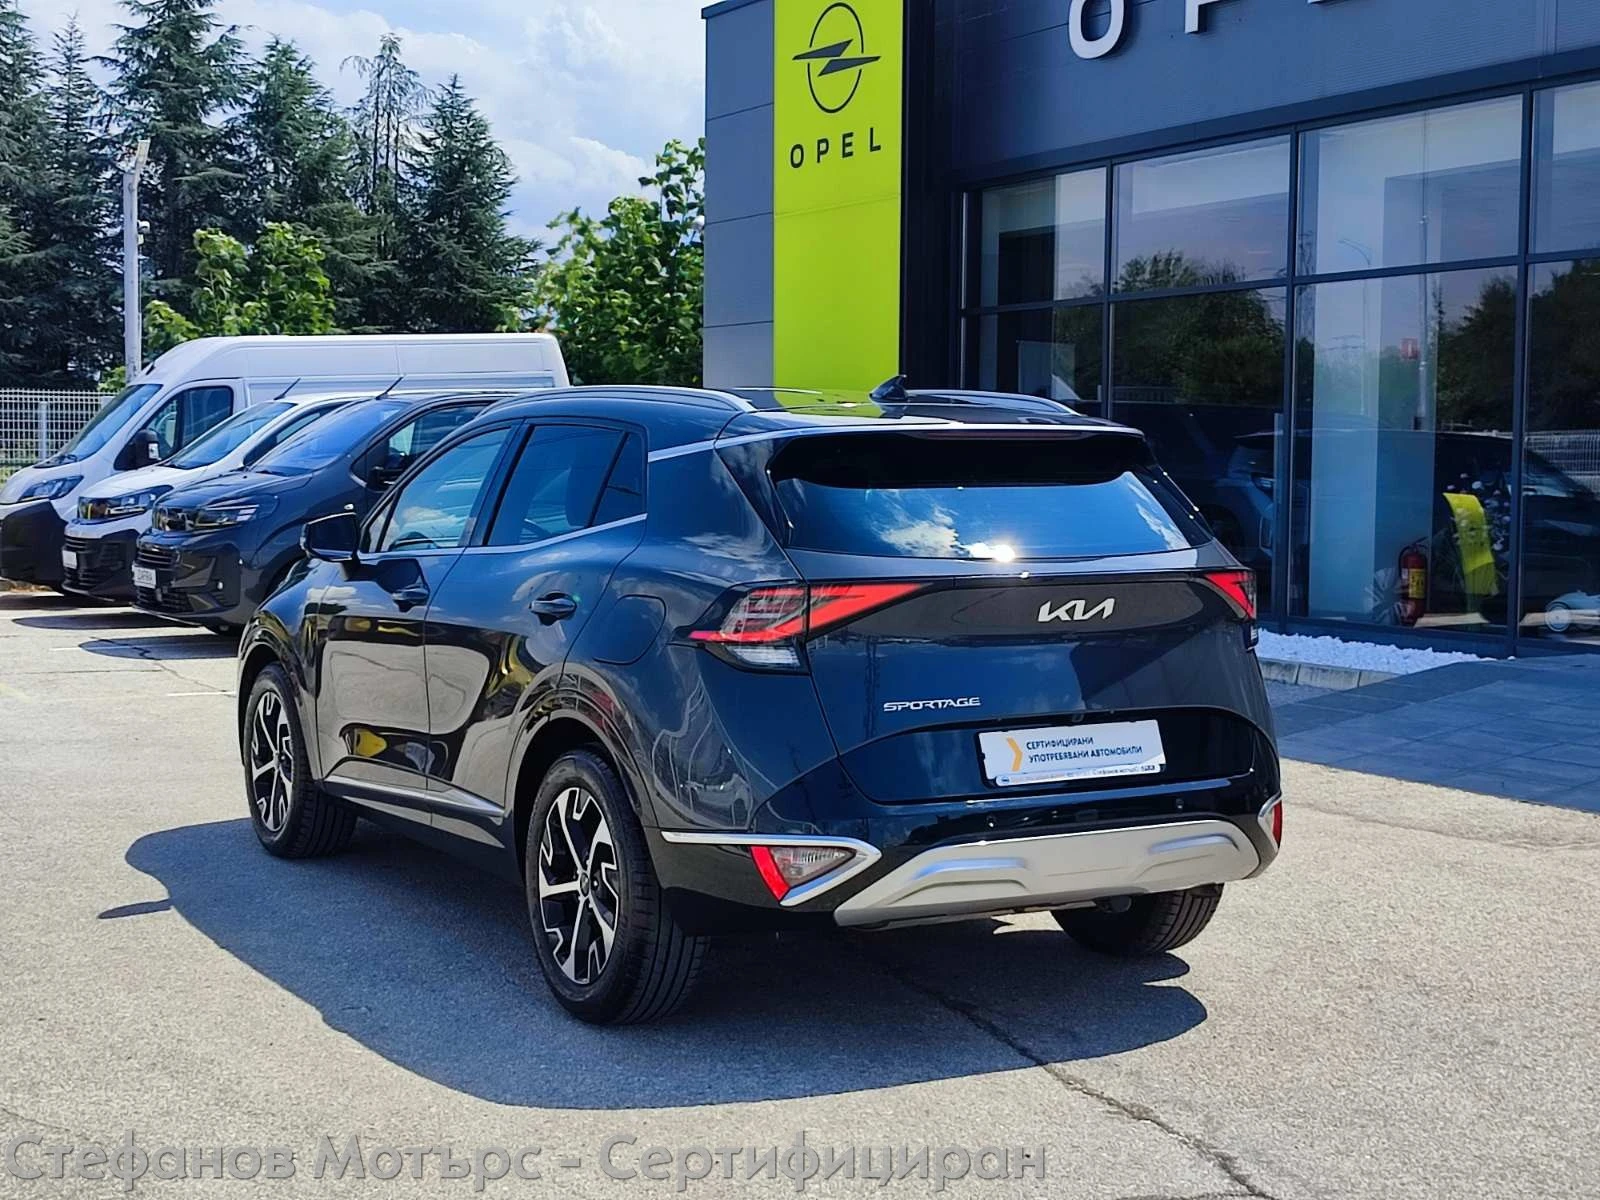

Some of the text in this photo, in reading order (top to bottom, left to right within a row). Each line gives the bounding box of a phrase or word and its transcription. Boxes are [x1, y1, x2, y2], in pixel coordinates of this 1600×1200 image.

[790, 127, 882, 169] OPEL
[883, 697, 981, 712] SPORTAGE
[1026, 737, 1094, 750] СЕРТИФИЦИРАНИ
[1029, 745, 1143, 763] УПОТРЕБЯВАНИ АВТОМОБИЛИ
